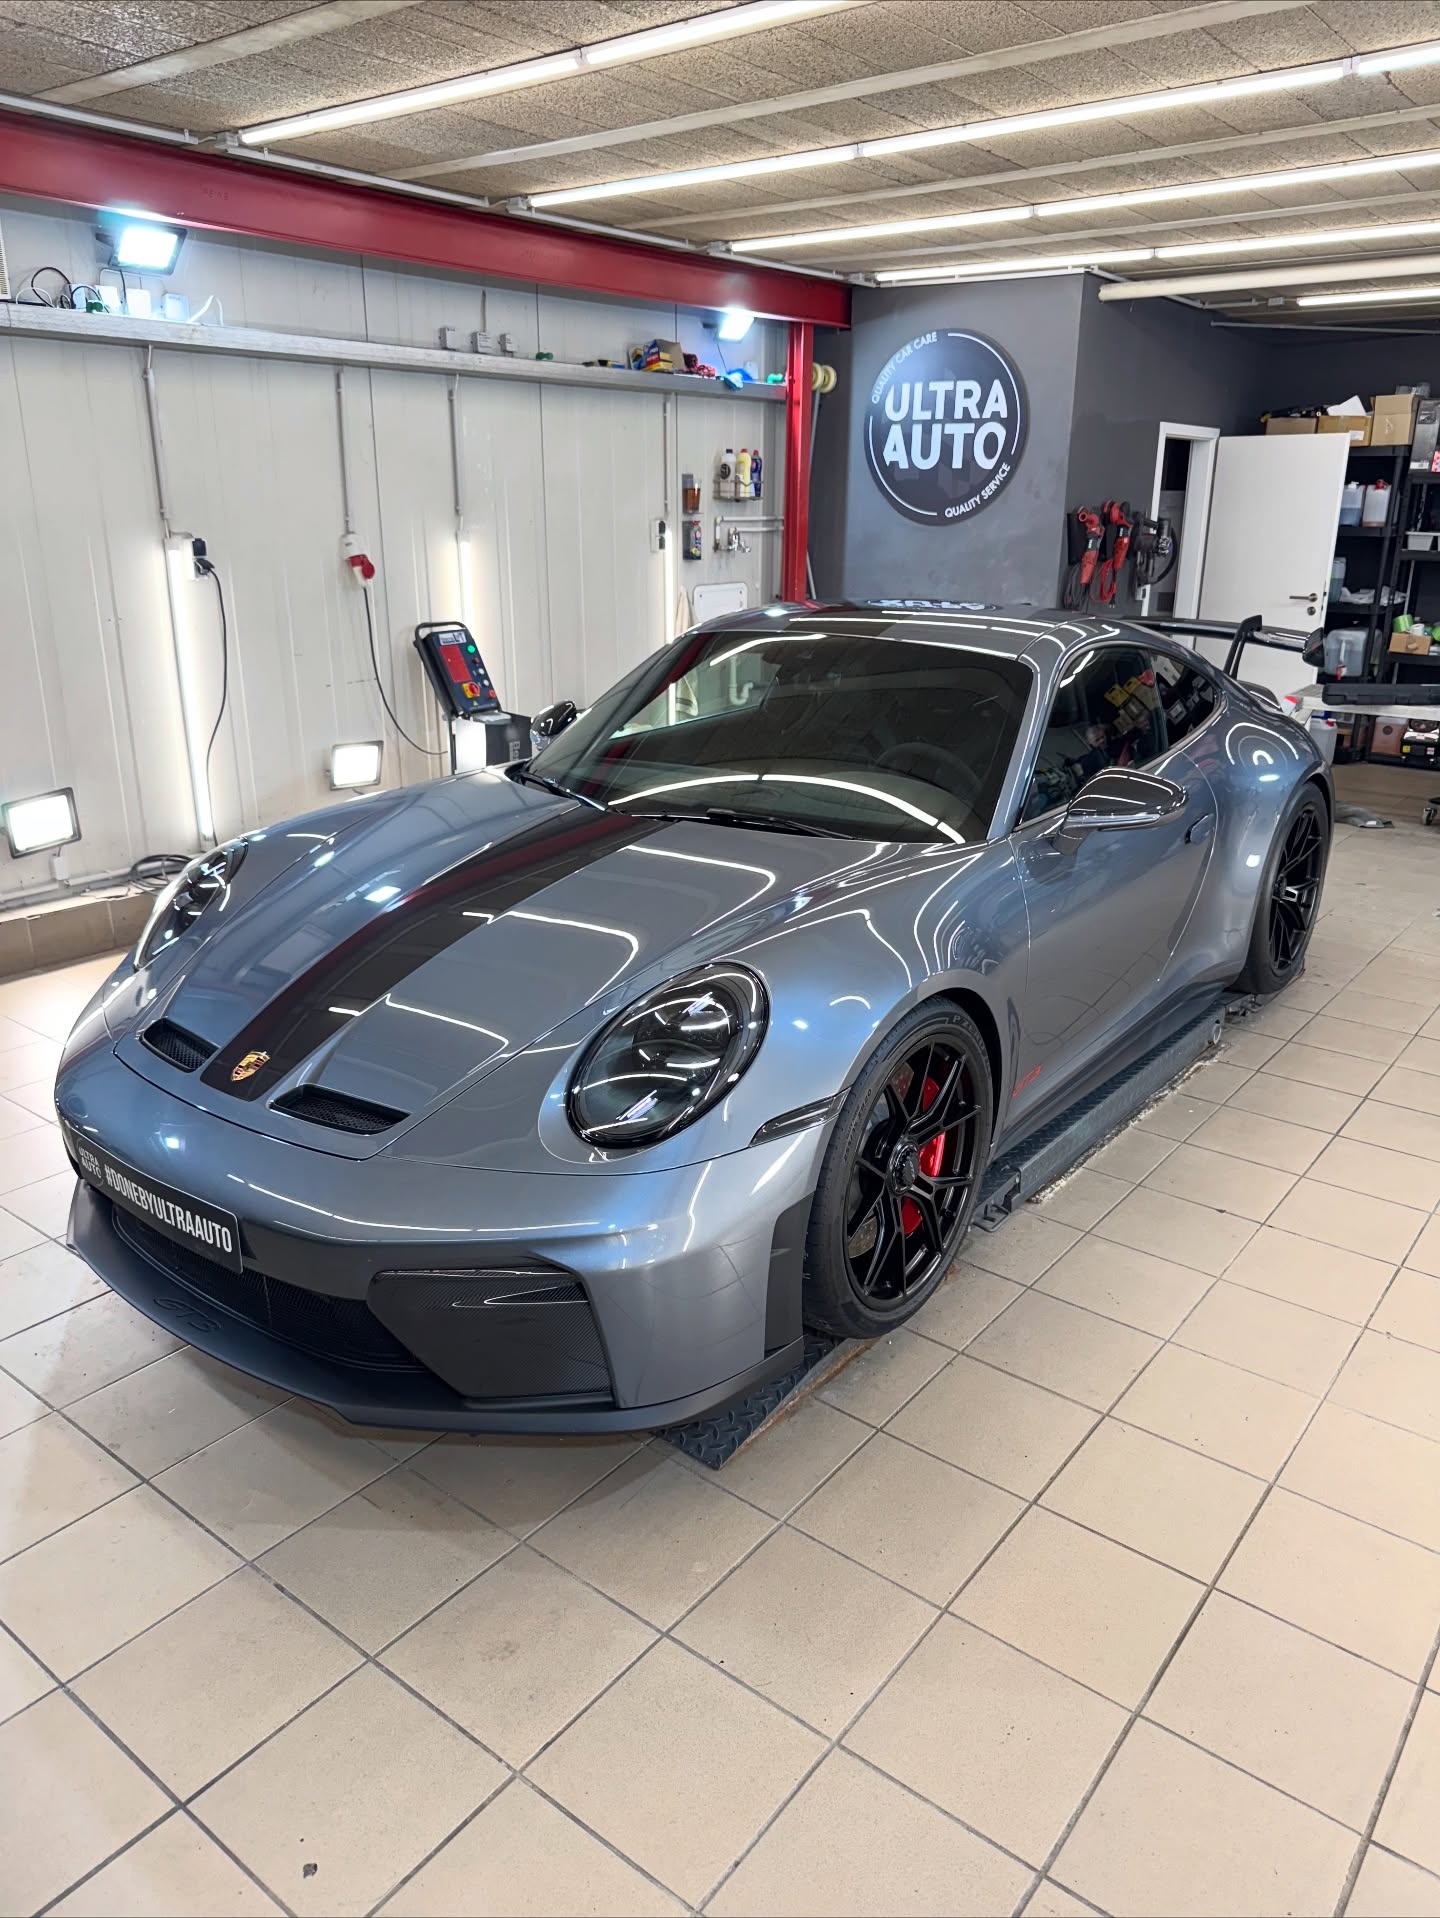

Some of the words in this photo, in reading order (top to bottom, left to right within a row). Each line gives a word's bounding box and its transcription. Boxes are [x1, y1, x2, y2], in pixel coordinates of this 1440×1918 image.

[871, 360, 896, 404] QUALITY
[895, 343, 914, 364] CAR
[913, 331, 938, 350] CARE
[884, 379, 1009, 422] ULTRA
[882, 421, 1007, 471] AUTO
[944, 494, 982, 519] QUALITY
[980, 462, 1011, 501] SERVICE
[1011, 1064, 1043, 1099] GT3
[78, 1147, 100, 1168] ULTRA
[81, 1156, 102, 1179] AUTO
[103, 1163, 233, 1253] #DONEBYULTRAAUTO
[153, 1296, 222, 1333] GT3
